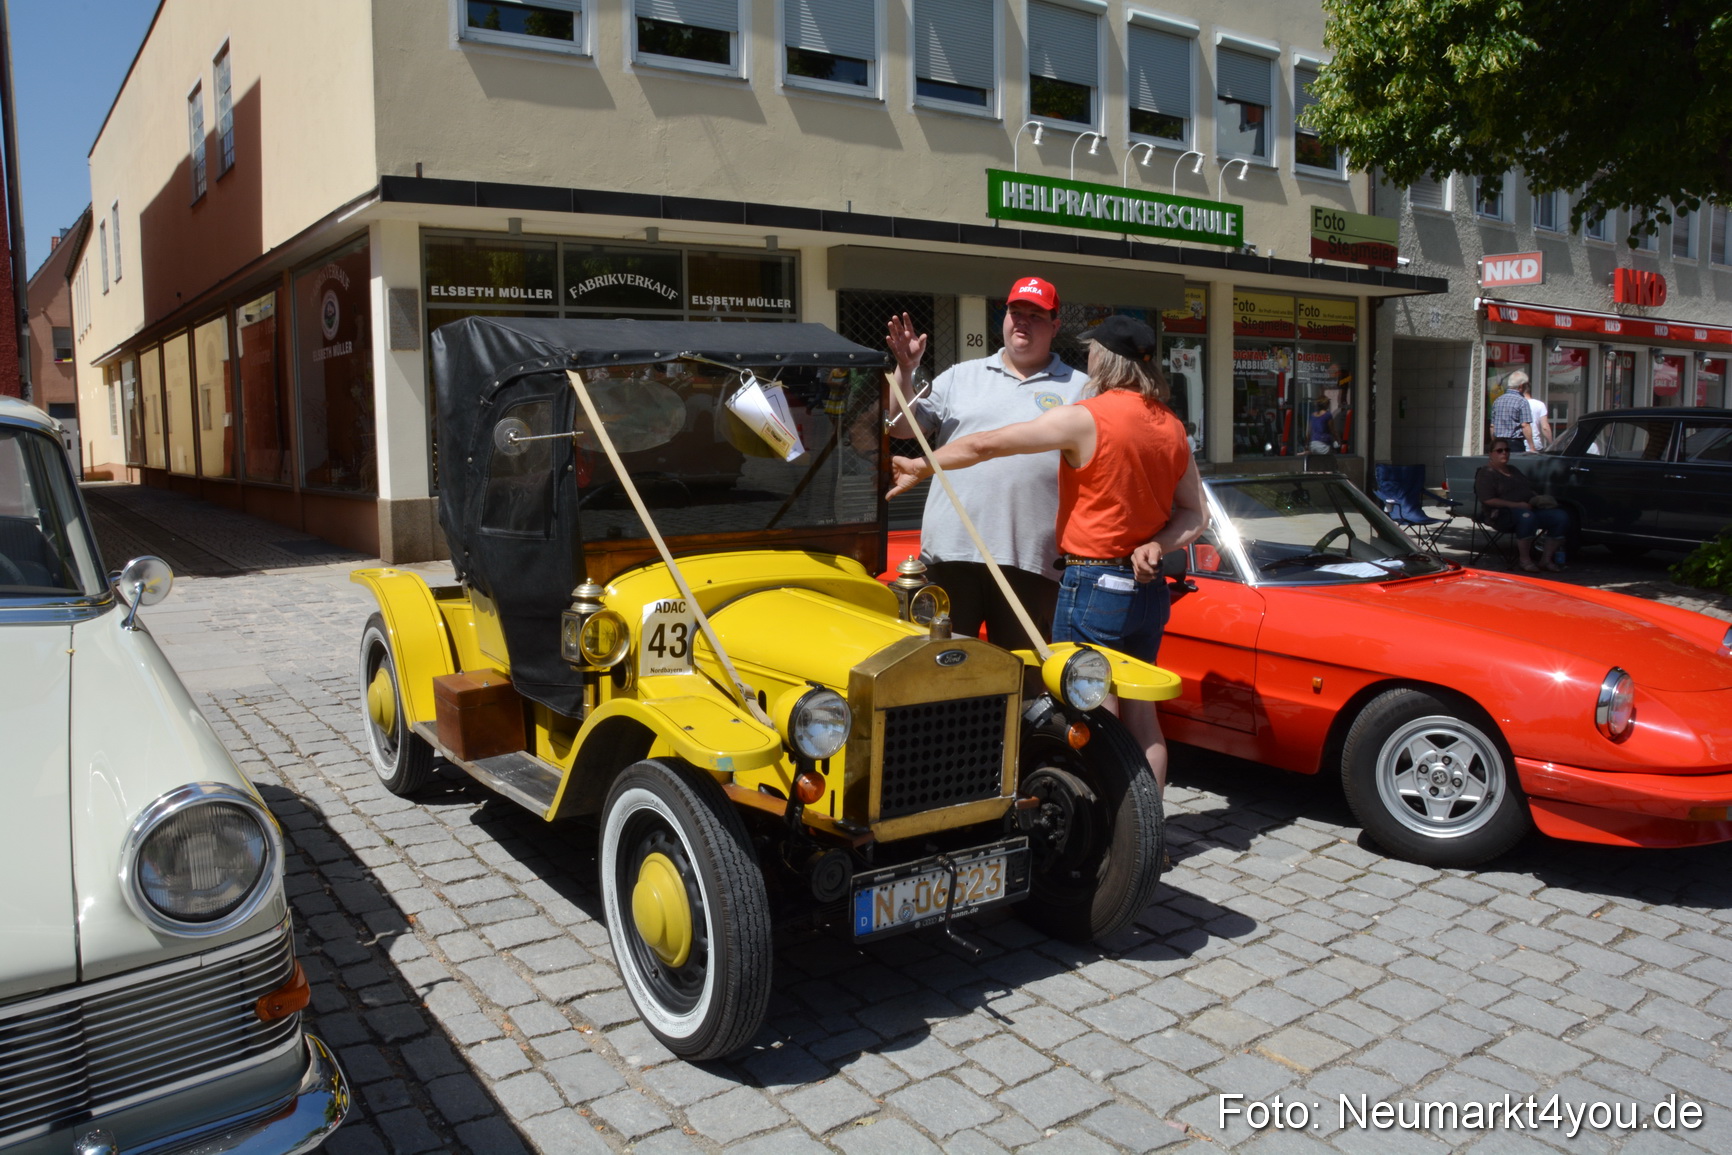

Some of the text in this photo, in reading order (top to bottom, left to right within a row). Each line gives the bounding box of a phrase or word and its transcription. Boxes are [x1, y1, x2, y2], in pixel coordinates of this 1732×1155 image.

[1002, 180, 1237, 236] HEILPRAKTIKERSCHULE
[1314, 208, 1345, 231] Foto
[1328, 234, 1395, 262] Stegmeier
[1485, 258, 1539, 282] NKD
[431, 285, 553, 299] ELSBETH MÜLLER
[568, 273, 679, 301] FABRIKVERKAUF
[1018, 286, 1043, 296] DEKRA
[1614, 267, 1667, 307] NKD
[691, 295, 792, 309] ELSBETH MÜLLER
[1233, 297, 1256, 313] Foto
[1298, 303, 1321, 318] Foto
[1499, 306, 1519, 322] NKD
[1241, 315, 1292, 334] Stegmeier
[1554, 313, 1572, 328] NKD
[1604, 319, 1621, 332] NKD
[1306, 320, 1356, 338] Stegmeier
[1654, 324, 1669, 337] NKD
[1693, 328, 1707, 341] NKD
[966, 333, 984, 348] 26
[333, 341, 353, 358] MÜLLER
[1233, 350, 1269, 361] DIGITALE
[1297, 353, 1331, 363] DIGITALE
[655, 601, 687, 614] ADAC
[647, 622, 688, 659] 43
[944, 653, 962, 664] Ford
[650, 666, 683, 674] Nordbayern
[861, 916, 869, 927] D
[875, 888, 894, 929] N
